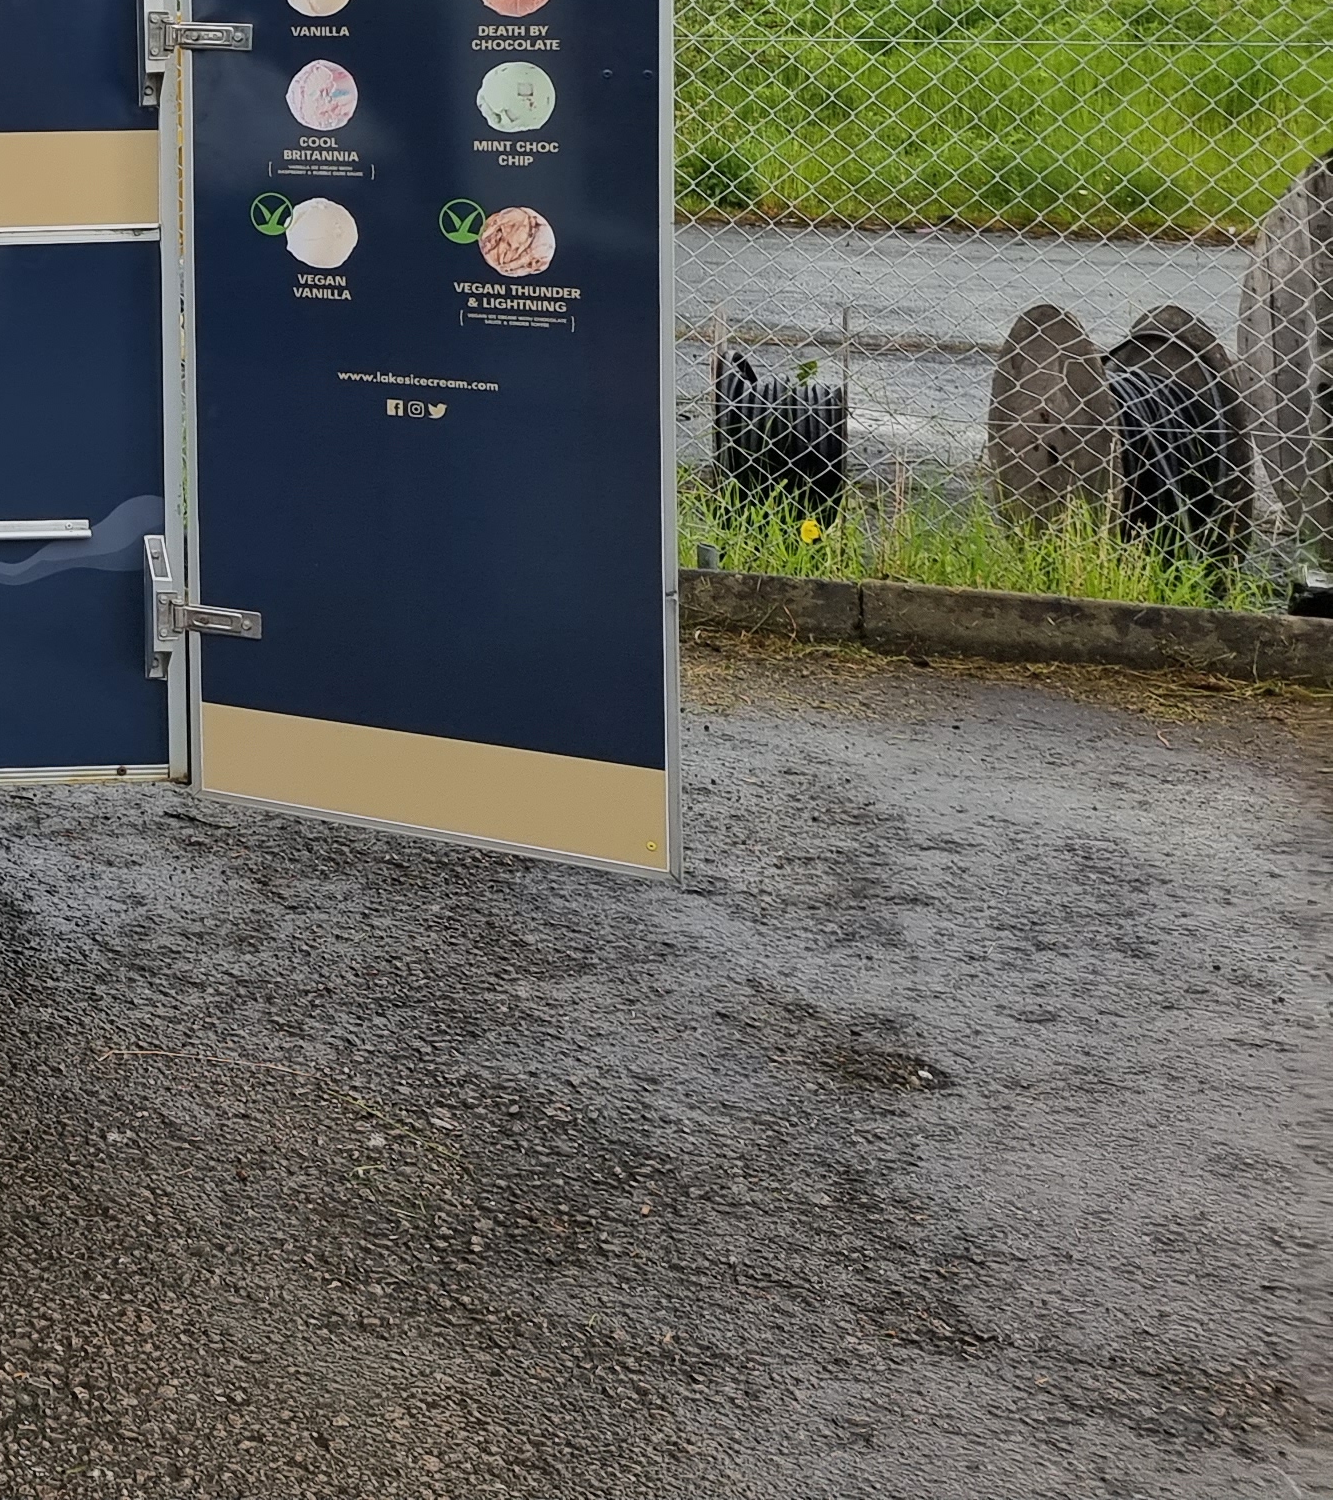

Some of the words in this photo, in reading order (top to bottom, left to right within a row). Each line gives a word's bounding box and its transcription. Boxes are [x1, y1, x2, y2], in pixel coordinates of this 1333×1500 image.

[291, 26, 350, 37] VANILLA
[478, 26, 525, 37] DEATH
[530, 25, 549, 36] BY
[471, 40, 561, 50] CHOCOLATE
[300, 137, 338, 148] COOL
[474, 141, 512, 151] MINT
[516, 142, 559, 152] CHOC
[284, 150, 359, 162] BRITANNIA
[499, 155, 533, 166] CHIP
[298, 274, 346, 286] VEGAN
[293, 287, 352, 300] VANILLA
[454, 282, 505, 295] VEGAN
[510, 285, 581, 299] THUNDER
[467, 298, 478, 307] &
[483, 299, 567, 312] LIGHTNING
[337, 371, 499, 392] www.lakesicecream.com
